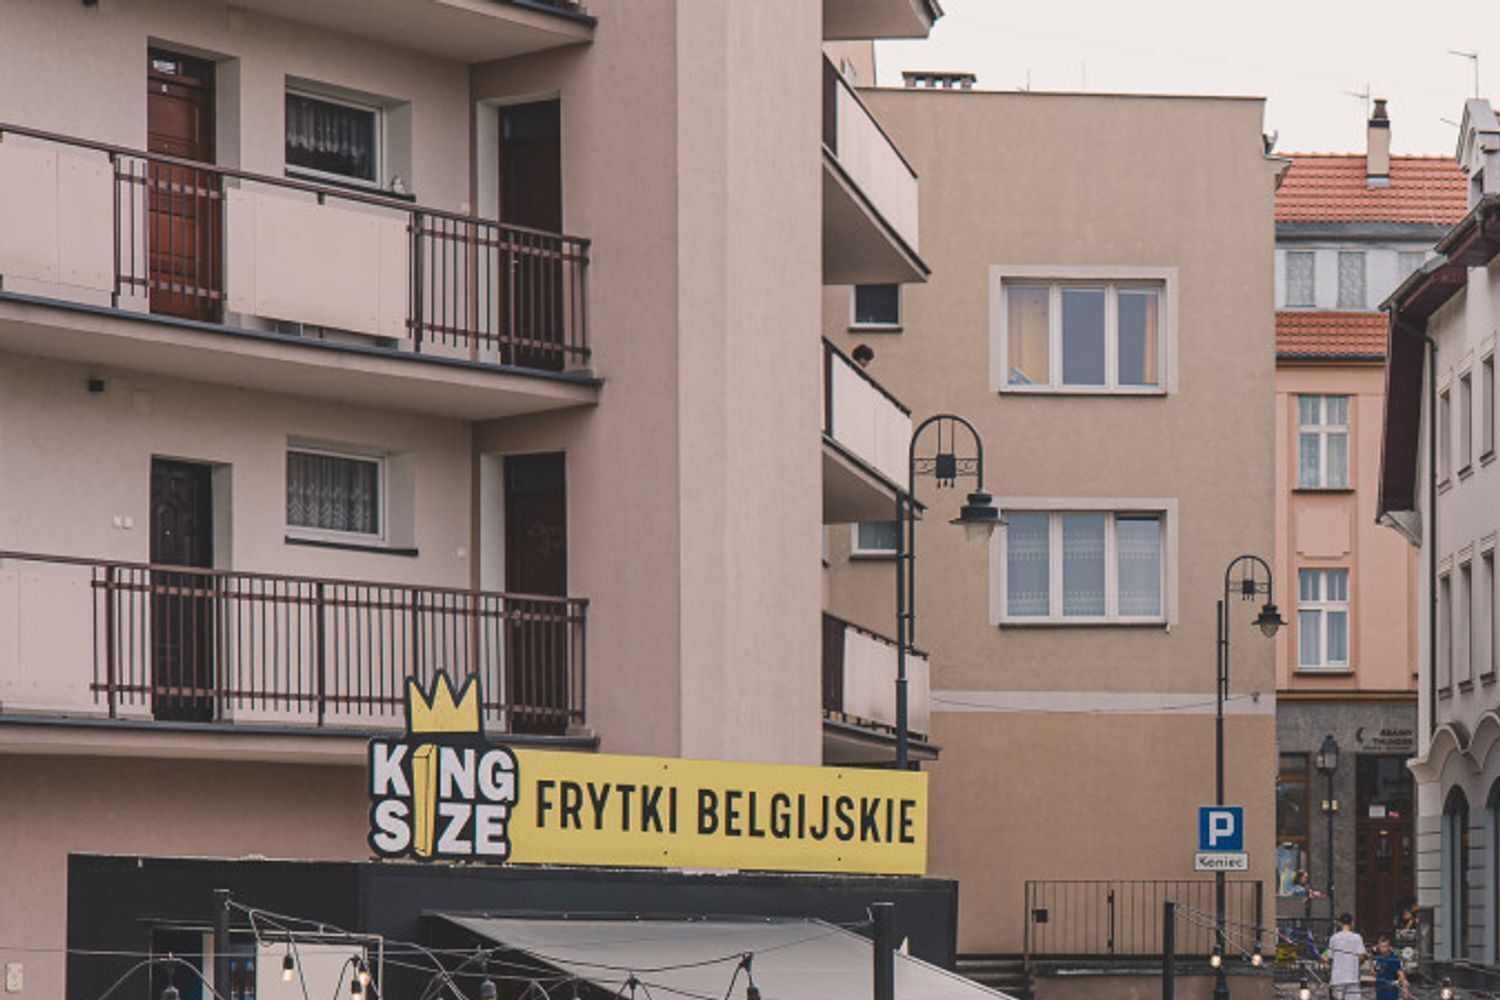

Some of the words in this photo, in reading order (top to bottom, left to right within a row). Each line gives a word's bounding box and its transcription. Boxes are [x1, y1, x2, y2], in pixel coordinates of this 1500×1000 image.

[373, 743, 515, 802] KING
[373, 799, 506, 857] SIZE
[536, 780, 677, 834] FRYTKI
[697, 788, 916, 844] BELGIJSKIE
[1208, 811, 1235, 846] P
[1199, 855, 1244, 869] Koniec
